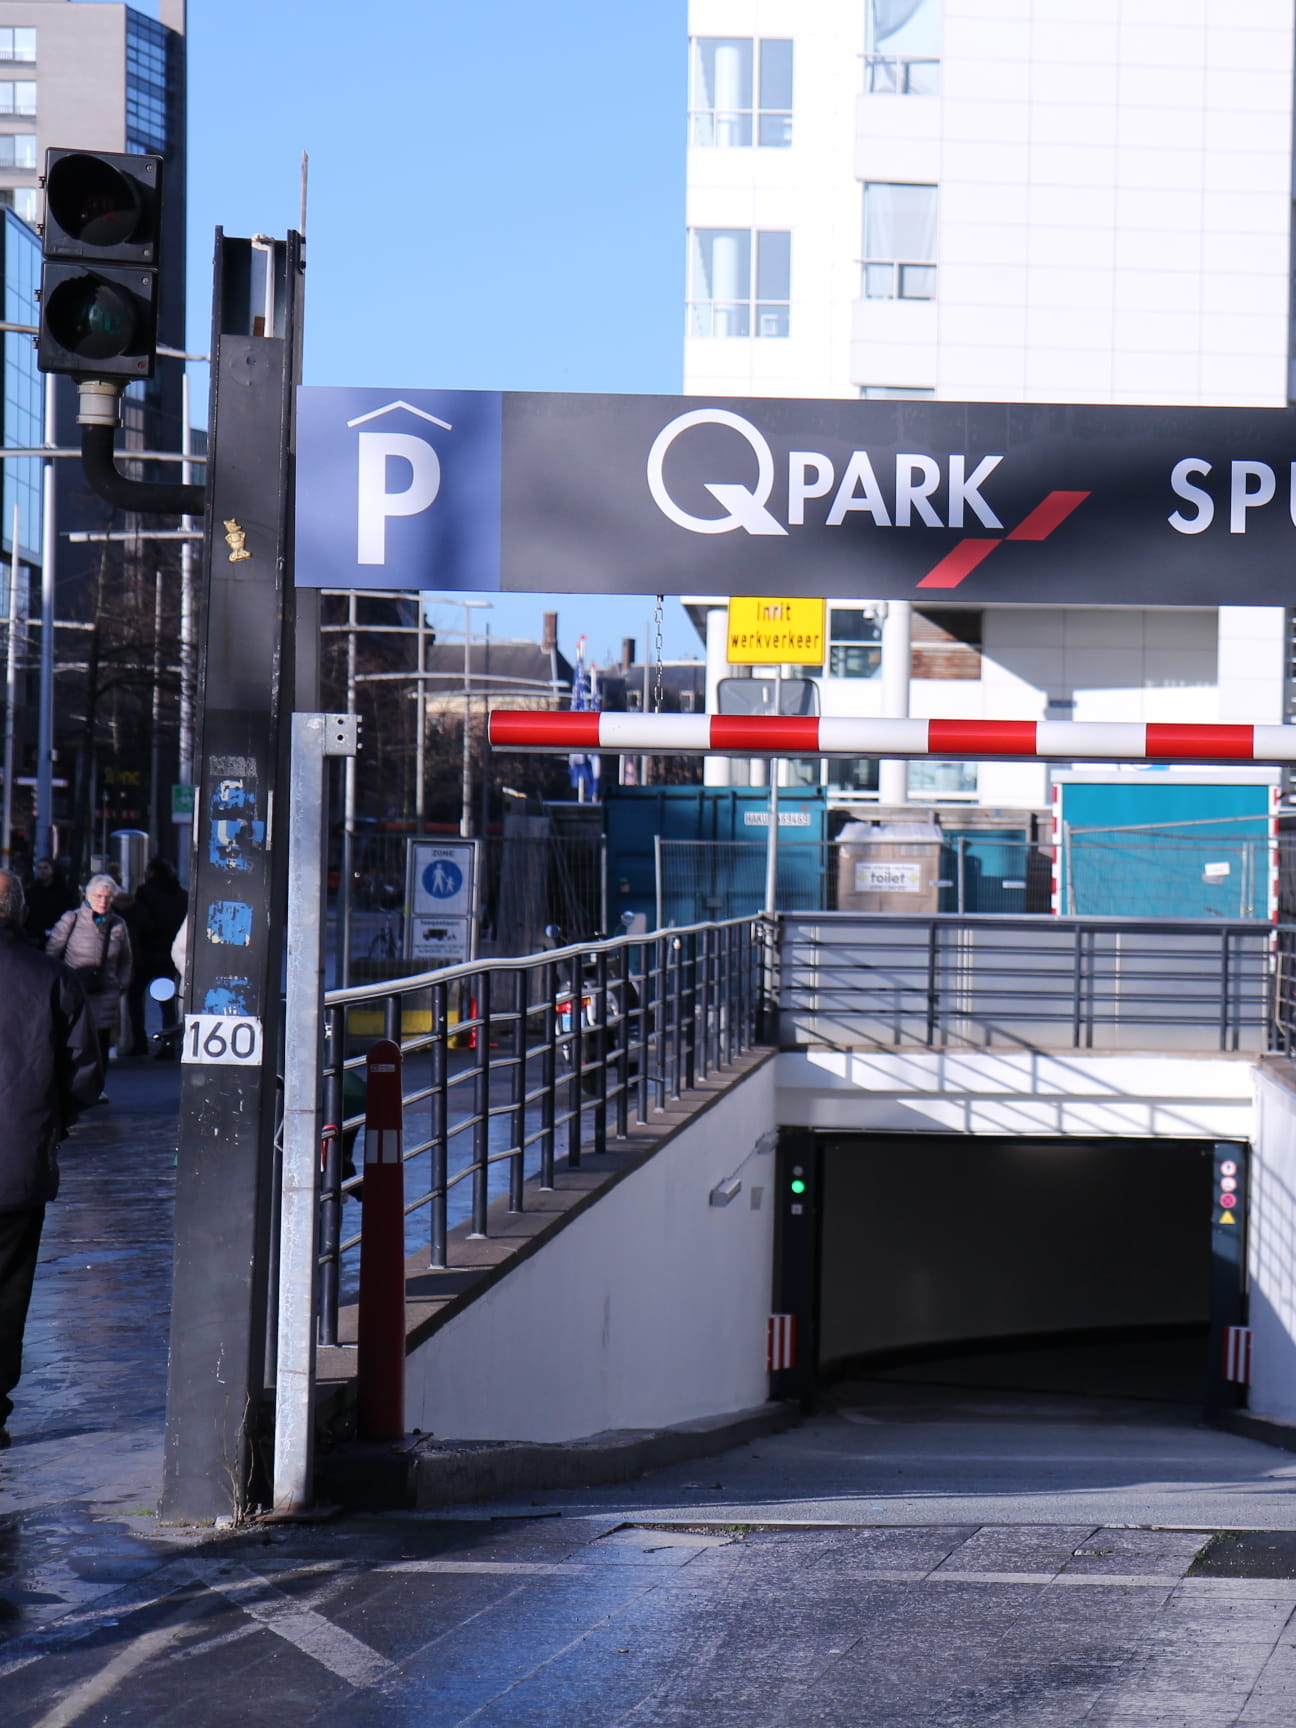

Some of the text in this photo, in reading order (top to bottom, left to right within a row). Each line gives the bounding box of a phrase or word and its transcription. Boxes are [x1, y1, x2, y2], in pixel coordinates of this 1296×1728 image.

[357, 432, 441, 564] P
[731, 631, 819, 649] werkverkeer
[871, 871, 905, 884] toilet
[189, 1021, 256, 1060] 160
